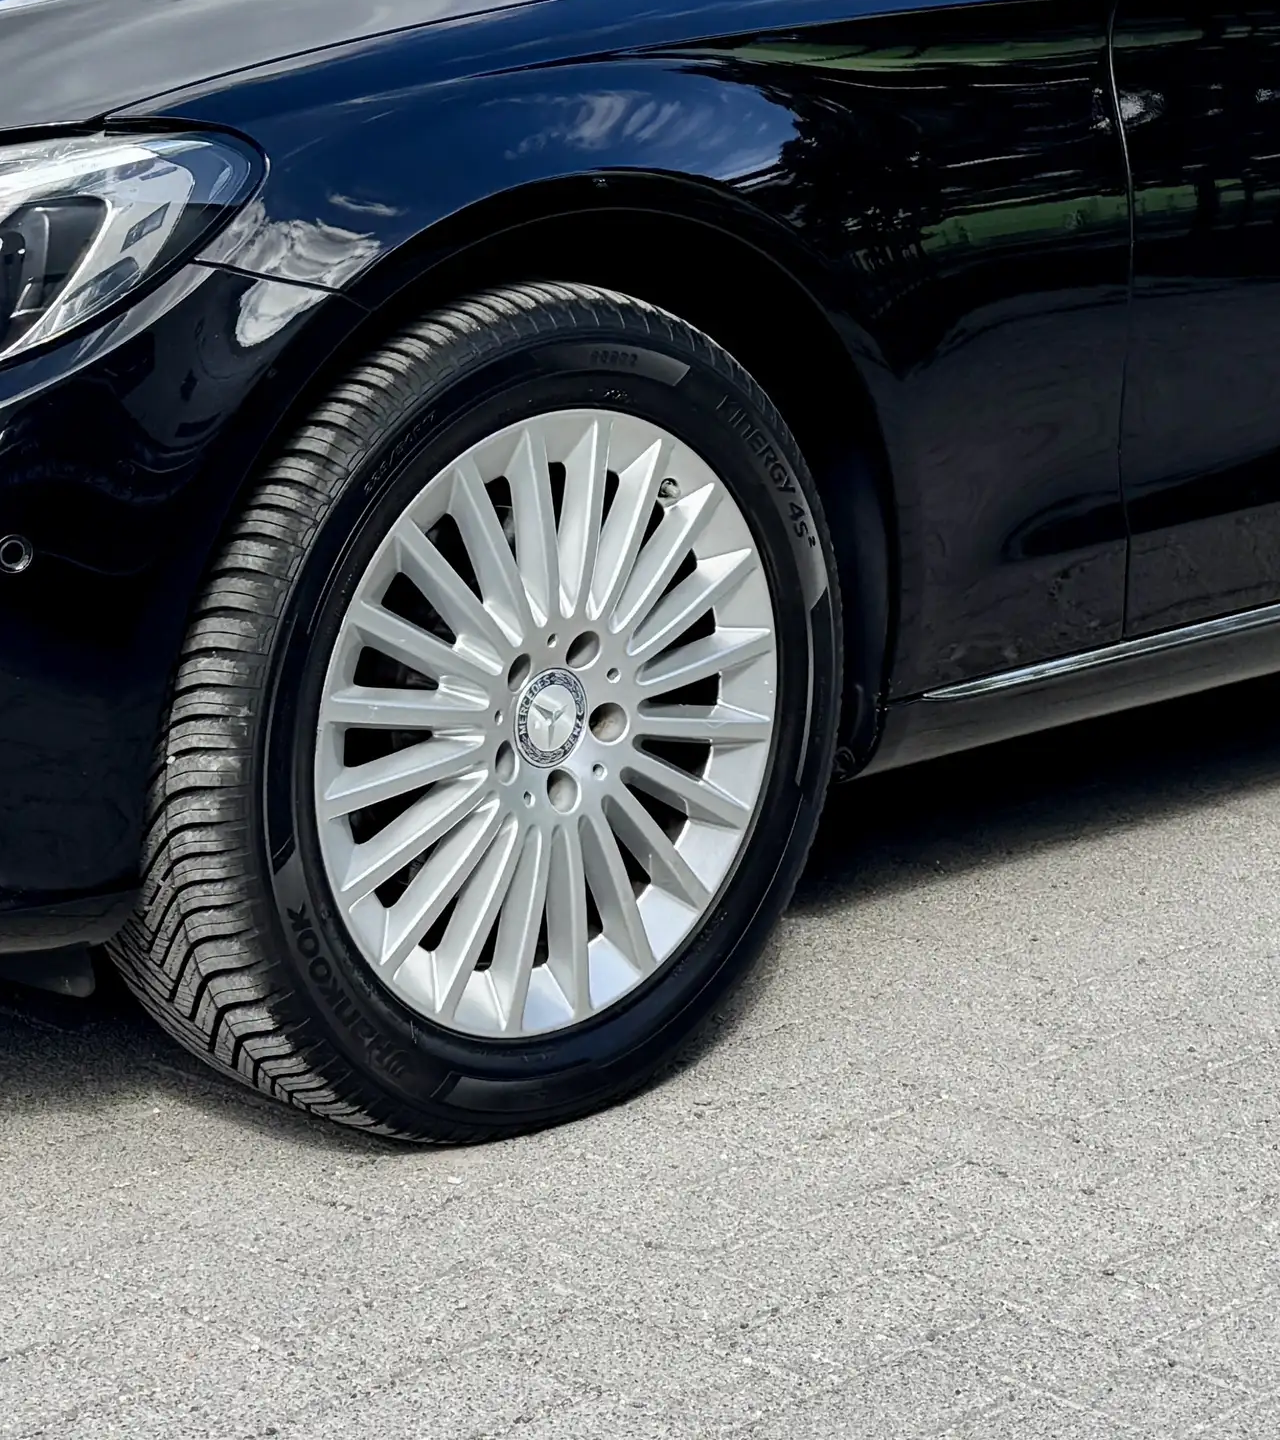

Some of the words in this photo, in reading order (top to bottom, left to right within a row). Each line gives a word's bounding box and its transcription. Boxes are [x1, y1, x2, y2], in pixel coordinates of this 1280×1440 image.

[716, 394, 796, 494] KINERGY
[518, 673, 552, 736] MERCEDES
[564, 719, 585, 751] BENZ
